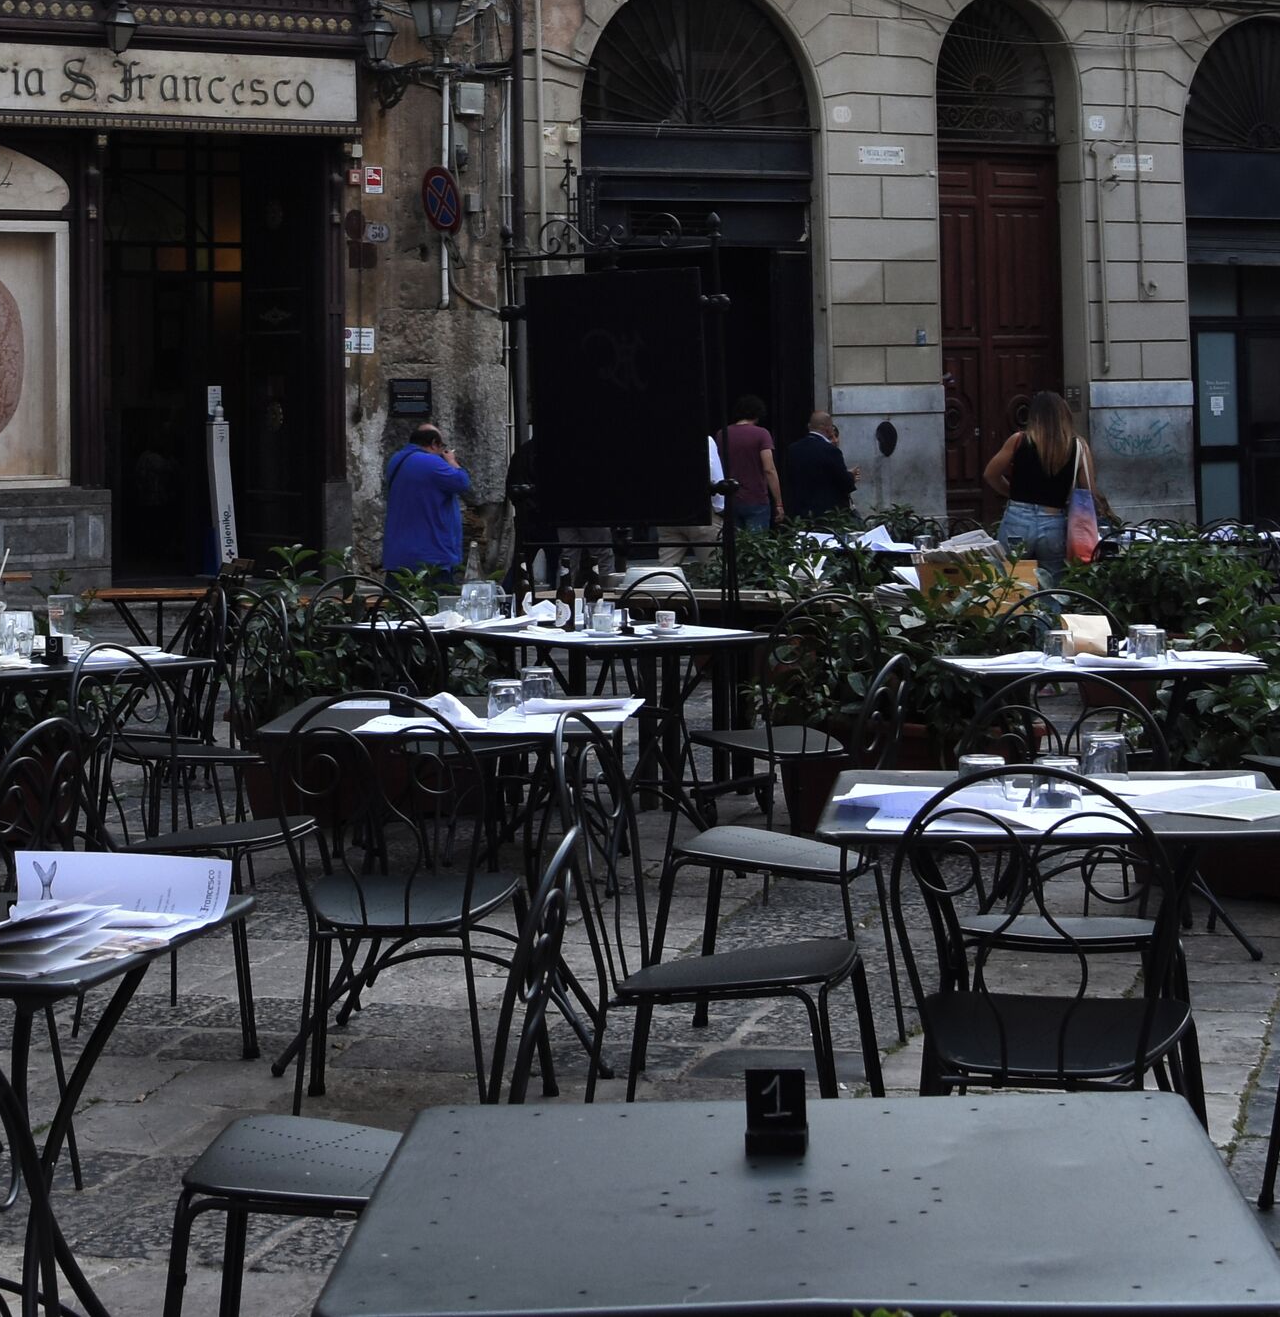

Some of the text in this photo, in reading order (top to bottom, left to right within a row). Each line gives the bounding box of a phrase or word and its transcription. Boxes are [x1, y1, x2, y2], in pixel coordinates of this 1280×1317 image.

[60, 58, 98, 102] S.
[107, 60, 315, 108] Francesco
[48, 638, 59, 654] 9
[760, 1074, 793, 1118] 1
